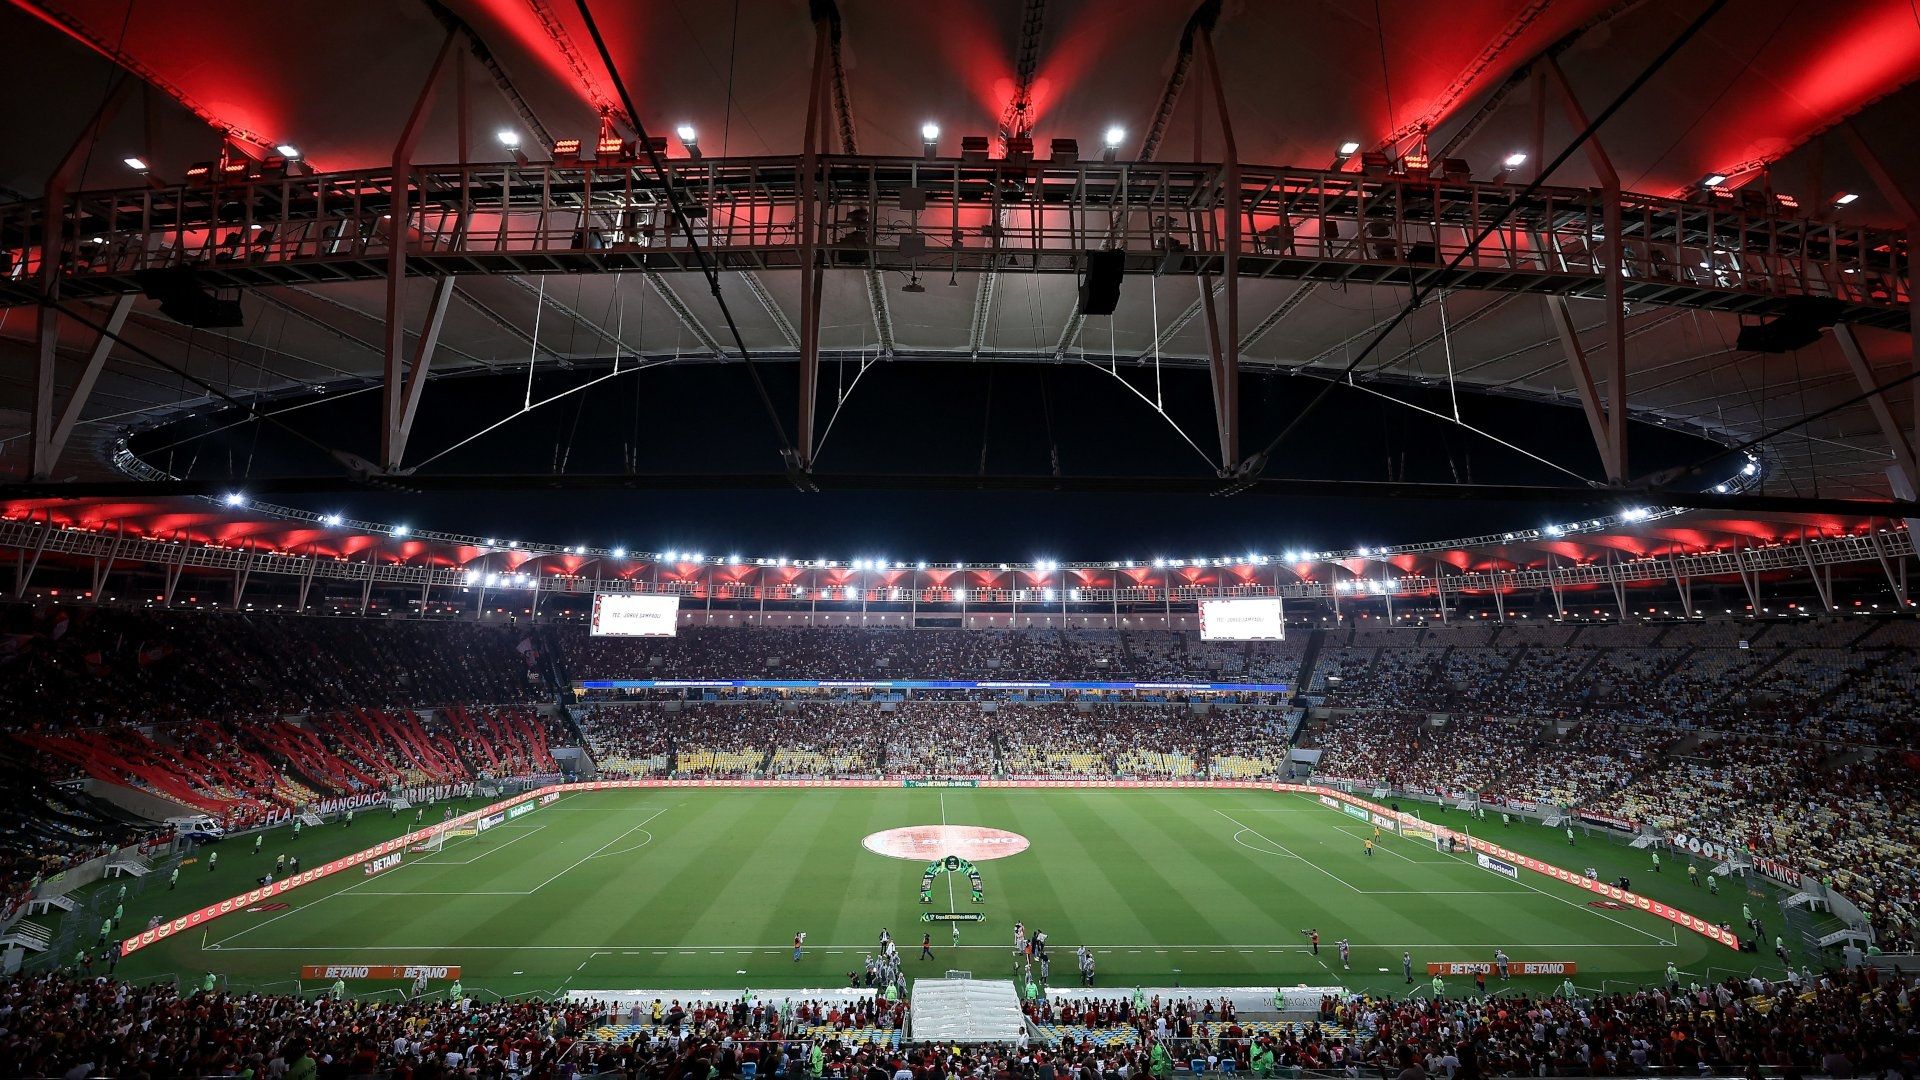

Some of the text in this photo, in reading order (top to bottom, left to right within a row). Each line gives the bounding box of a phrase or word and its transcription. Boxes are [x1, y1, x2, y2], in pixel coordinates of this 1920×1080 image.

[266, 807, 291, 827] FLA
[373, 852, 402, 873] BETANO
[324, 967, 448, 979] BETANO BETANO
[1524, 963, 1565, 974] BETANO
